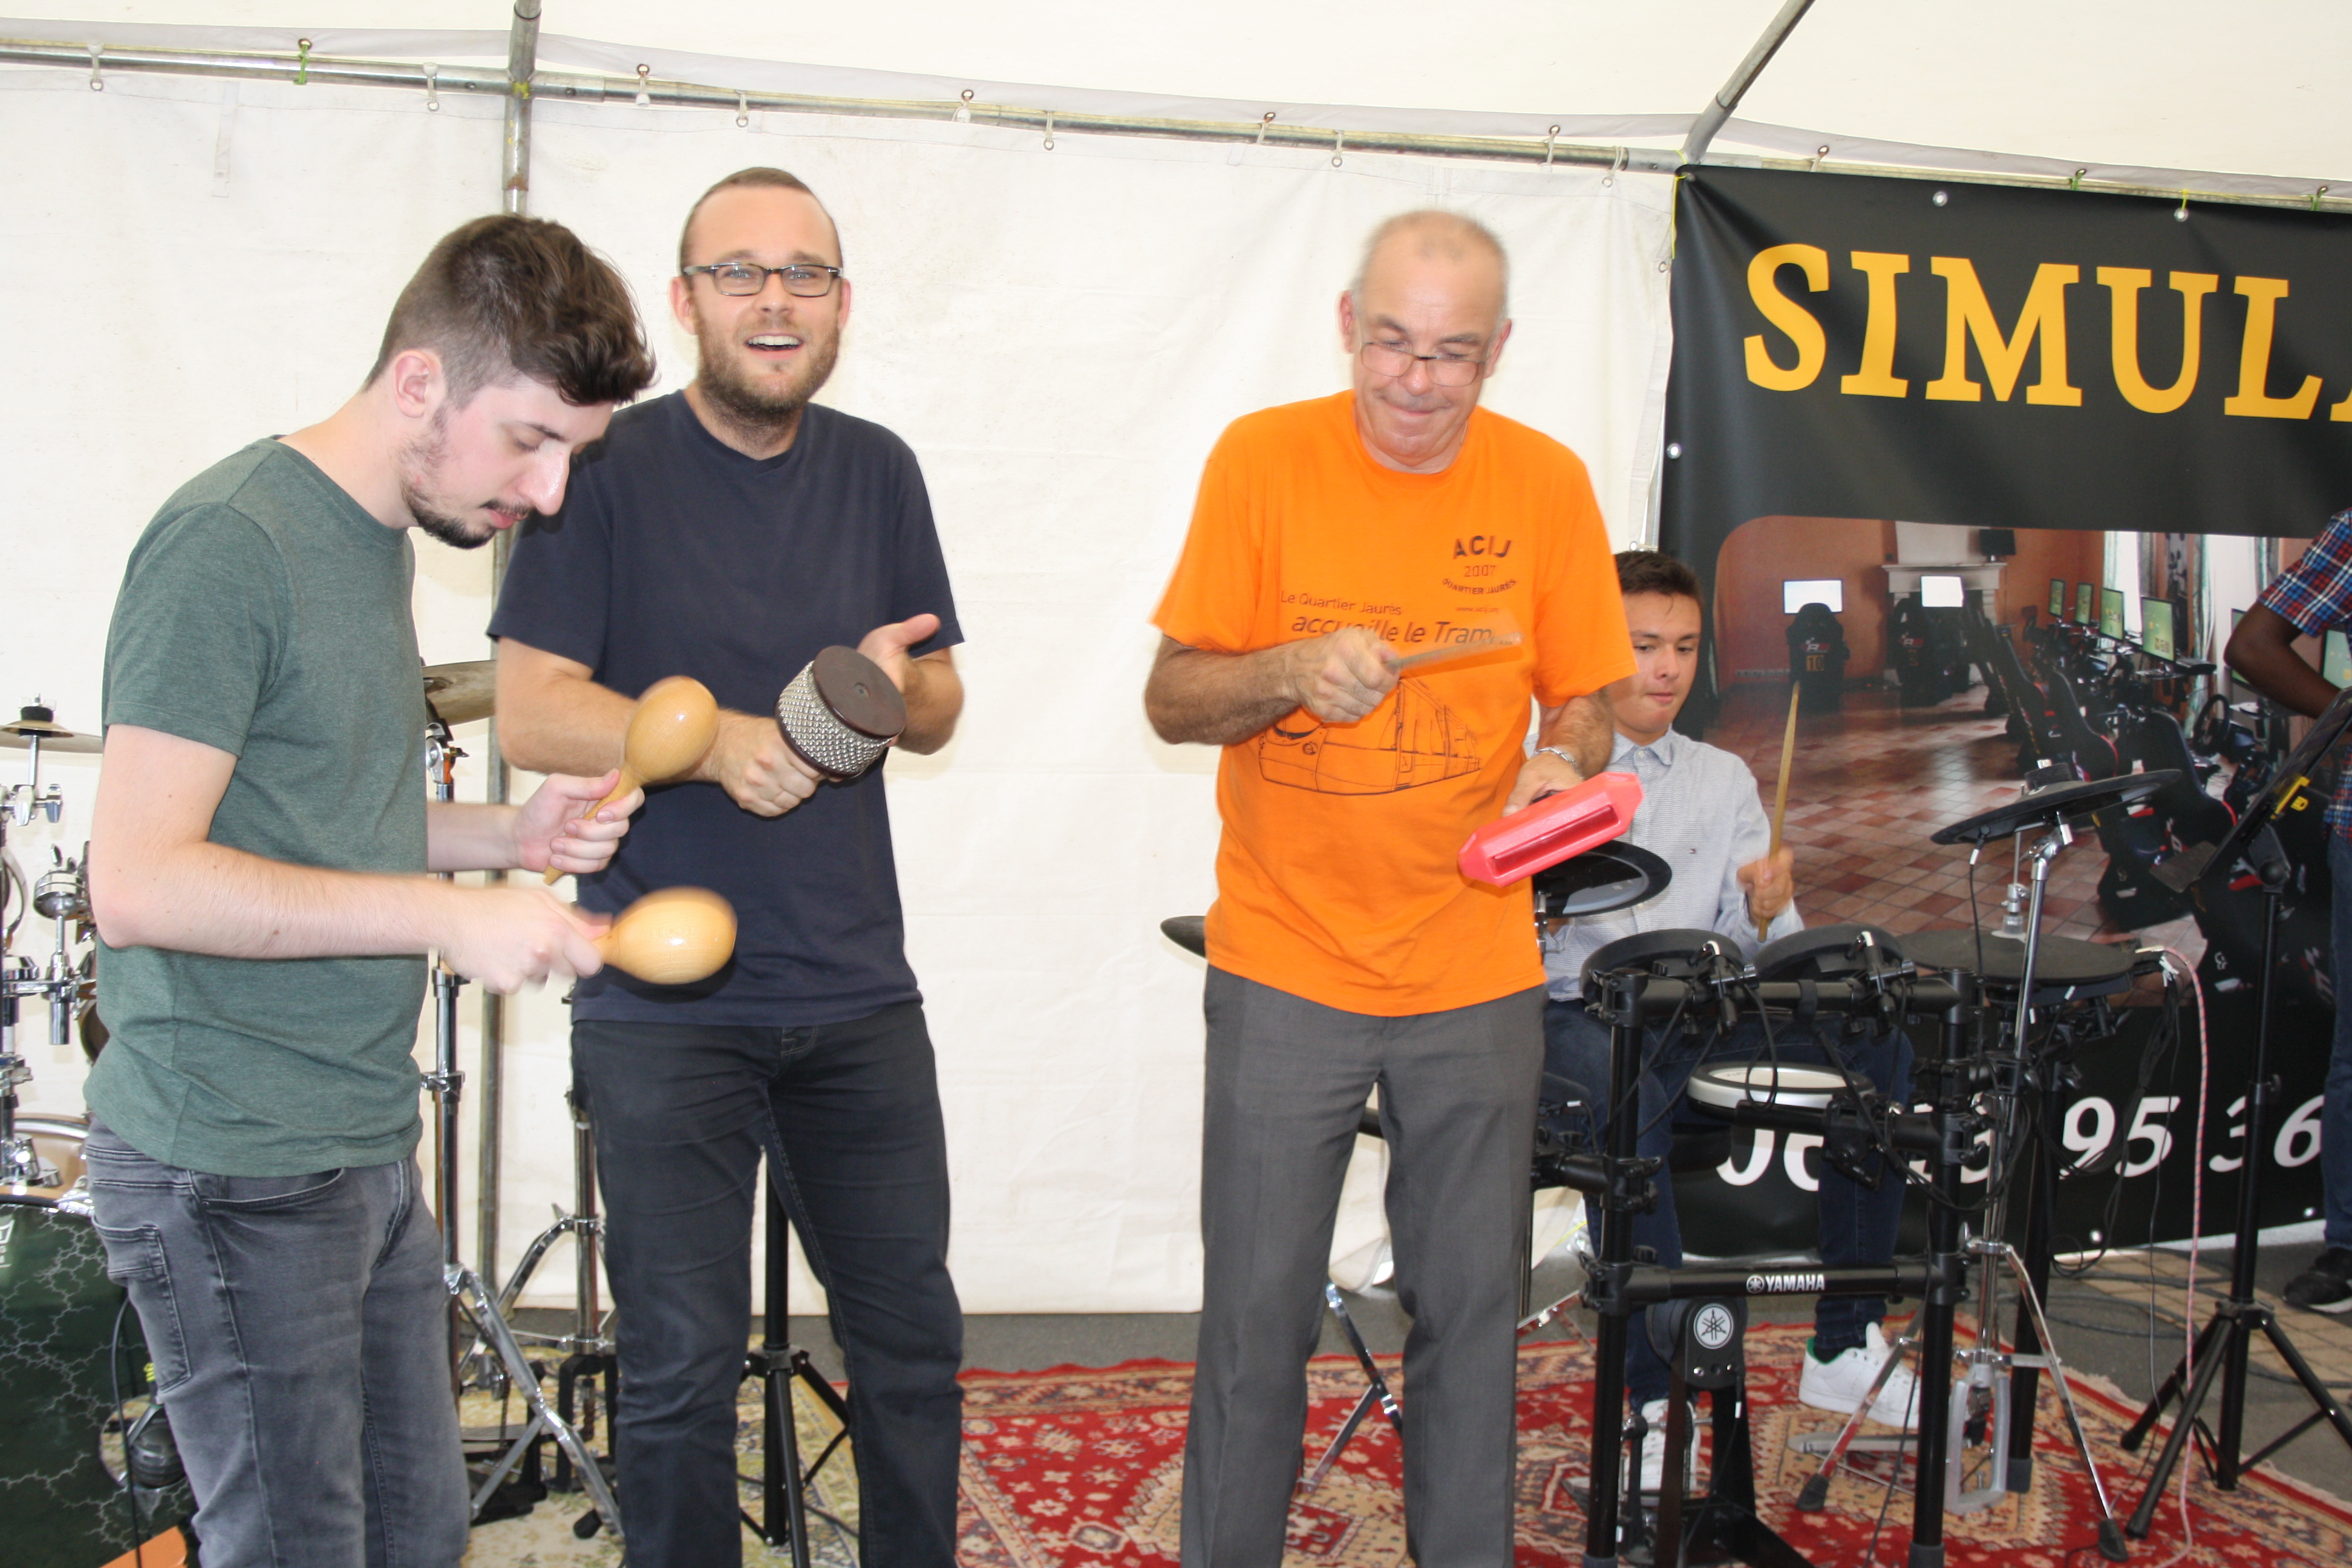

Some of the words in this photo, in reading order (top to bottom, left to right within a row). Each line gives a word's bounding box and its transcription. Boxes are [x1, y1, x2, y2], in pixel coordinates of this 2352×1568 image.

[1744, 243, 2352, 422] SIMUL
[1452, 535, 1512, 560] ACIJ
[1464, 564, 1497, 577] 2007
[1442, 578, 1484, 595] QUARTIER
[1281, 590, 1296, 604] Le
[1299, 593, 1356, 611] Quartier
[1403, 621, 1426, 643] le
[2059, 1096, 2181, 1180] 95
[1765, 1273, 1825, 1292] YAMAHA
